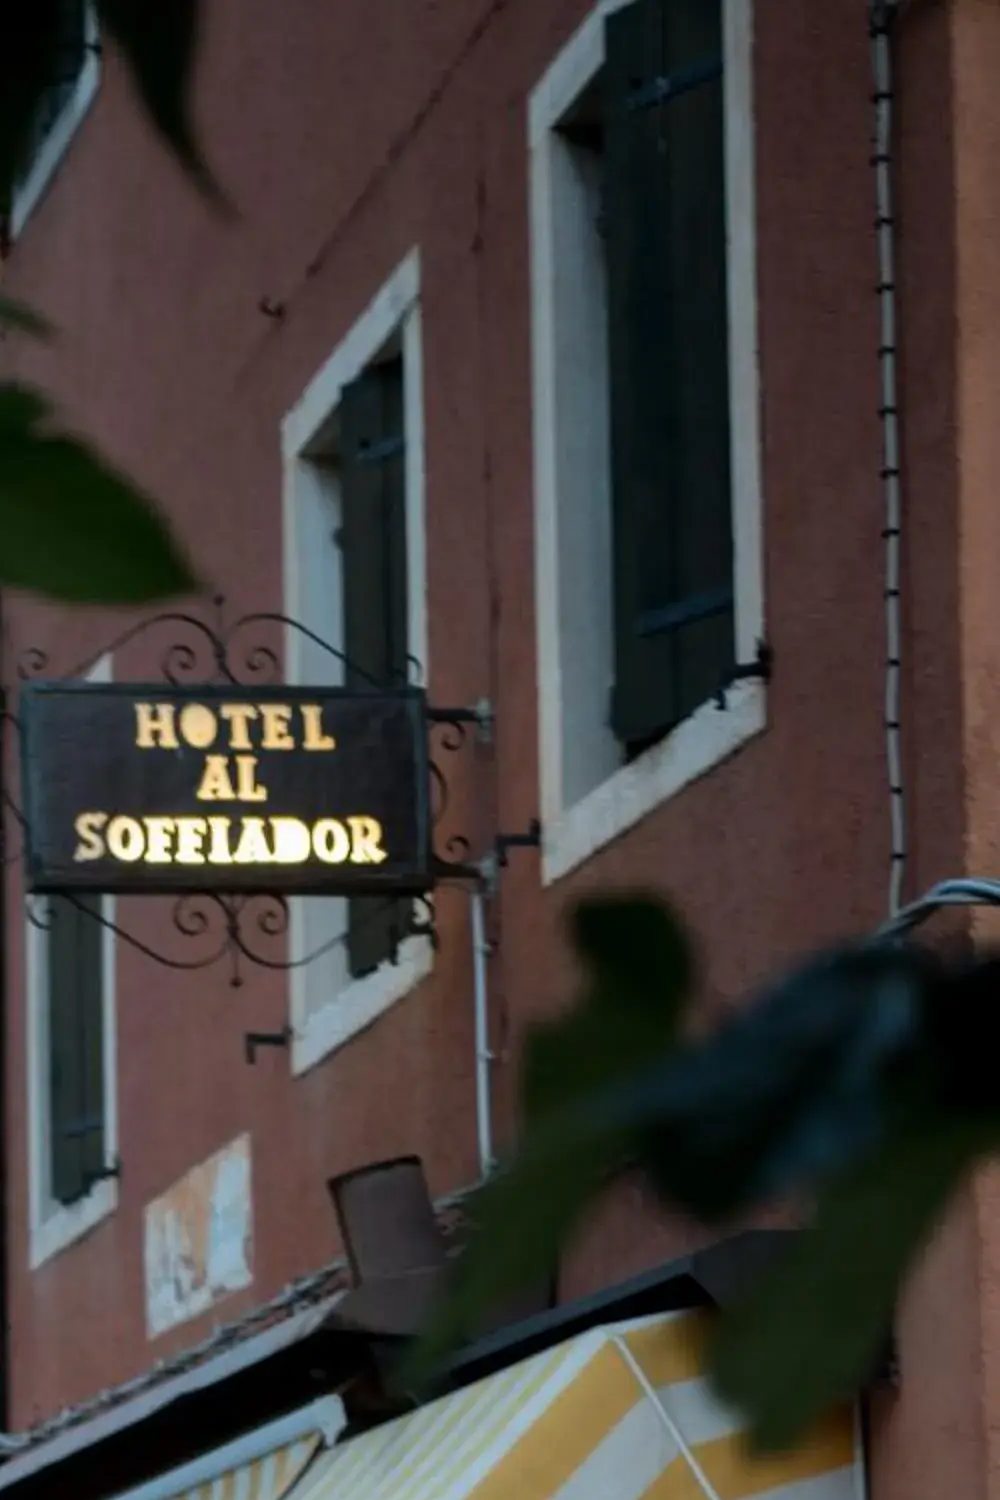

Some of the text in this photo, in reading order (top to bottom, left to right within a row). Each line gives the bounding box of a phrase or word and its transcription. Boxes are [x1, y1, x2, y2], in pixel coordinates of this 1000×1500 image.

[135, 703, 335, 751] HOTEL
[197, 755, 268, 802] AL
[73, 811, 389, 864] SOFFIADOR
